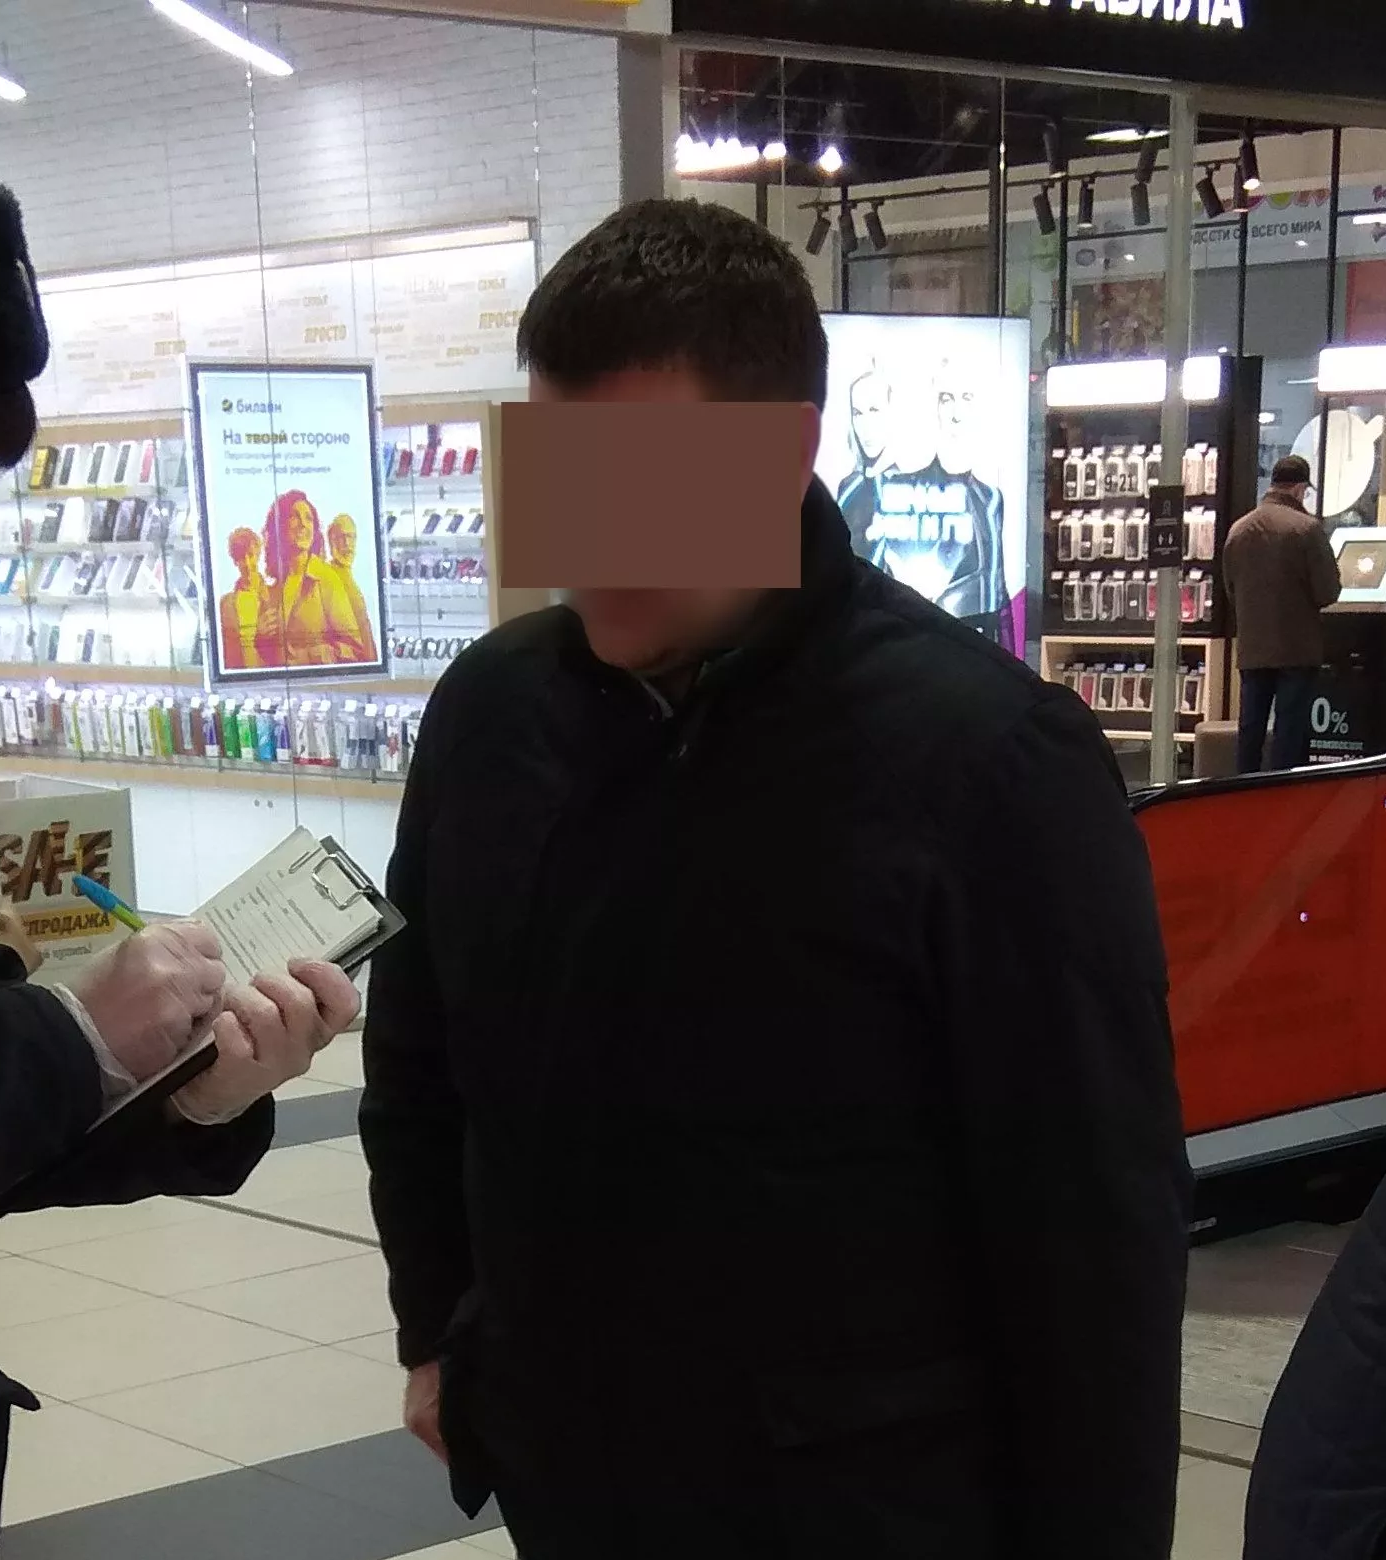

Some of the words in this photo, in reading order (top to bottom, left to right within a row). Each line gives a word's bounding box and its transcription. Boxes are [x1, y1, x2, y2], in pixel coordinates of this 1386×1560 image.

[1251, 223, 1288, 238] ВСЕГО
[1290, 219, 1322, 234] МИРА
[236, 398, 282, 414] билайн
[223, 429, 242, 445] На
[245, 429, 288, 445] твоей
[291, 431, 351, 449] стороне
[1311, 696, 1349, 734] 0%
[23, 912, 111, 936] ПРОДАЖА
